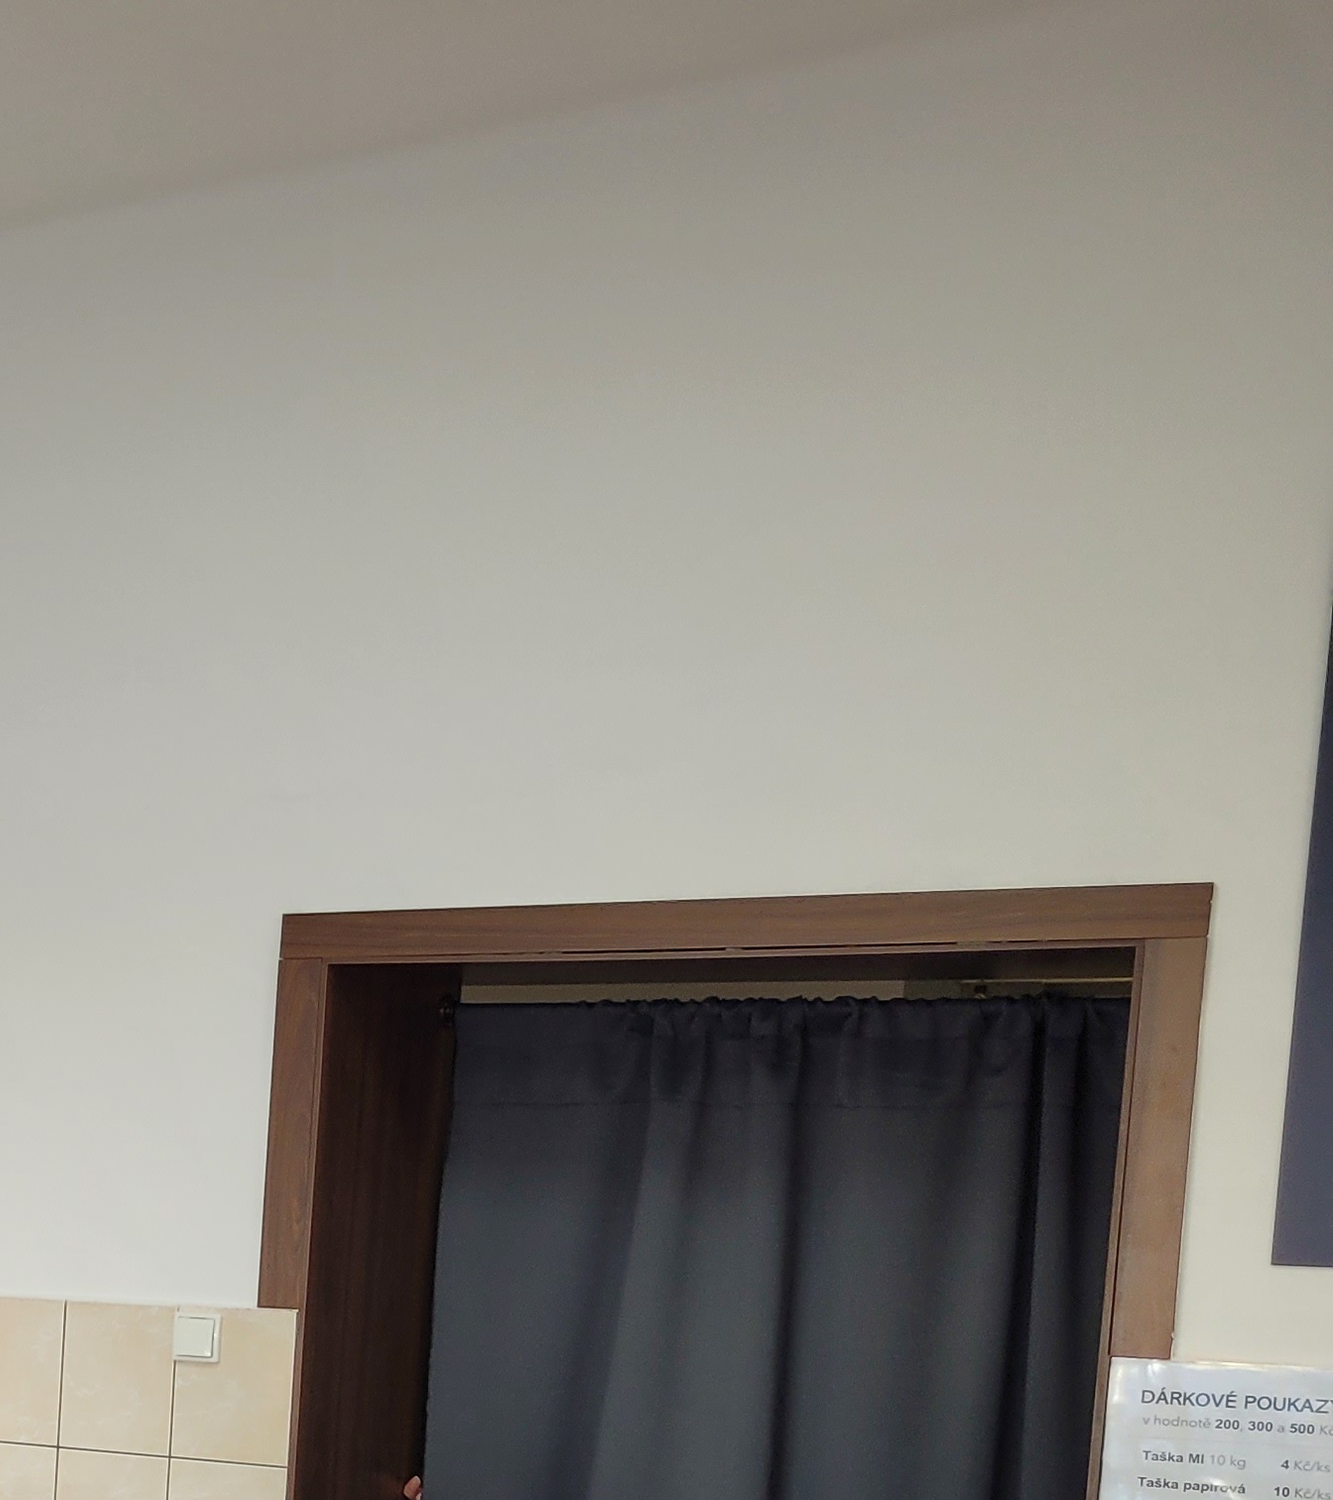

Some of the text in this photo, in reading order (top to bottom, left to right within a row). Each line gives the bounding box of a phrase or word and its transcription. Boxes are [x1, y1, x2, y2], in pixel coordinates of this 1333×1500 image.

[1141, 1387, 1333, 1415] DÁRKOVÉ POUKAZ
[1142, 1417, 1151, 1425] v
[1153, 1415, 1211, 1429] hodnotě
[1248, 1421, 1273, 1433] 300
[1289, 1423, 1315, 1435] 500
[1142, 1450, 1184, 1464] Taška
[1209, 1454, 1225, 1466] 10
[1229, 1455, 1246, 1470] kg
[1281, 1459, 1290, 1470] 4
[1294, 1461, 1331, 1473] Kč/ks
[1138, 1477, 1179, 1490] Taška
[1274, 1486, 1290, 1498] 10
[1294, 1487, 1331, 1500] Kč/ks
